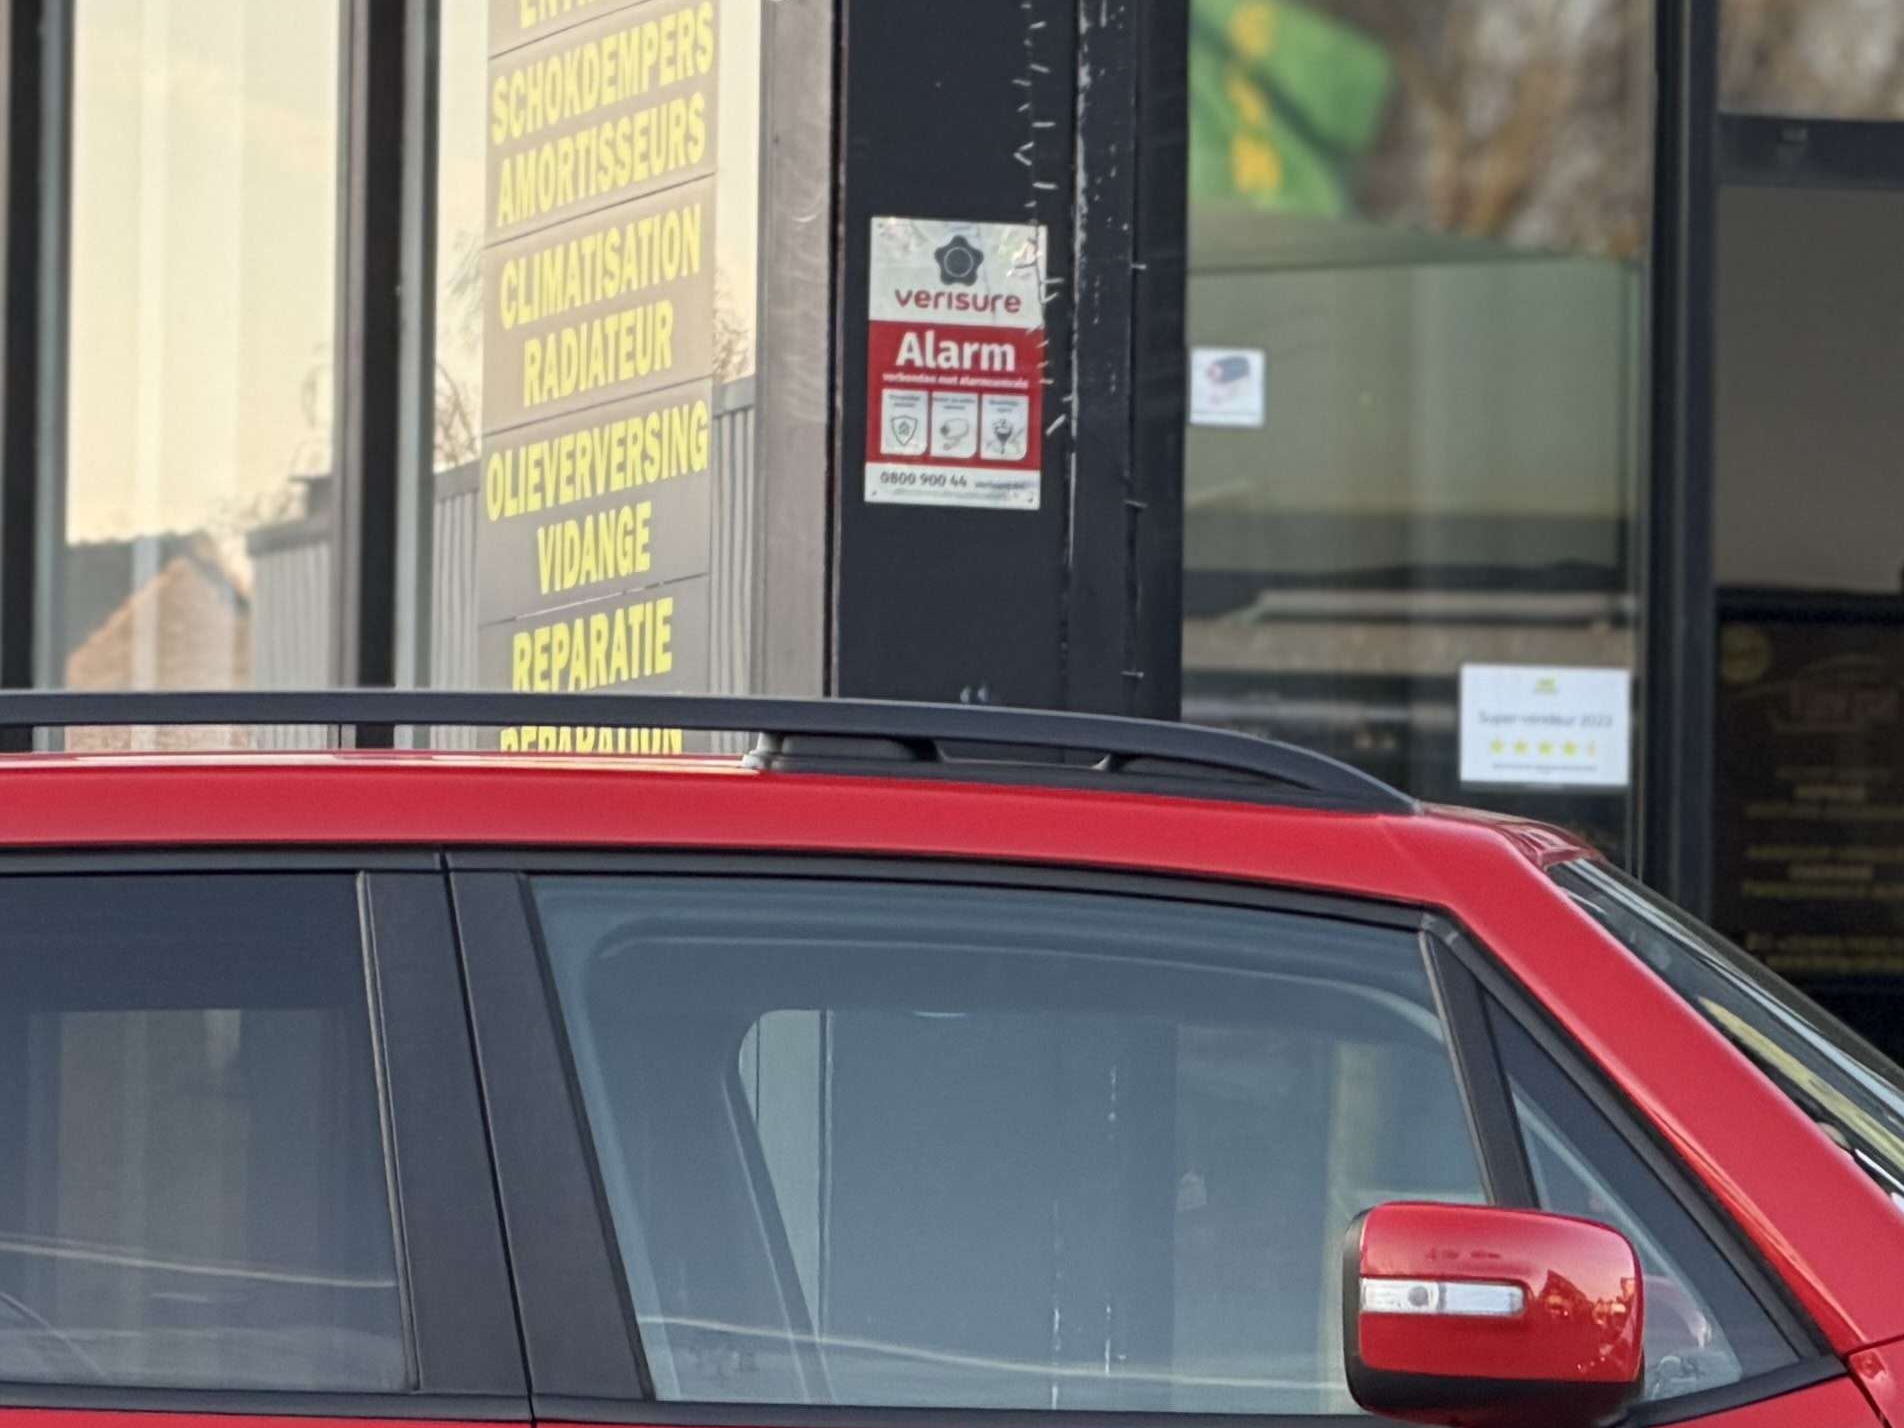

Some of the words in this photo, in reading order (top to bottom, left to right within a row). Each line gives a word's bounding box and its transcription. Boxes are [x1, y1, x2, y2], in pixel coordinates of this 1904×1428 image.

[491, 1, 714, 146] SCHOKDEMPERS
[497, 91, 706, 227] AMORTISSEURS
[500, 203, 702, 329] CLIMATISATION
[895, 288, 1022, 313] verisure
[524, 300, 674, 407] RADIATEUR
[895, 330, 1016, 372] Alarm
[486, 400, 710, 521] OLIEVERVERSING
[880, 471, 918, 486] 0800
[920, 473, 947, 488] 900
[950, 474, 968, 489] 44
[537, 501, 652, 594] VIDANGE
[512, 597, 674, 693] REPARATIE
